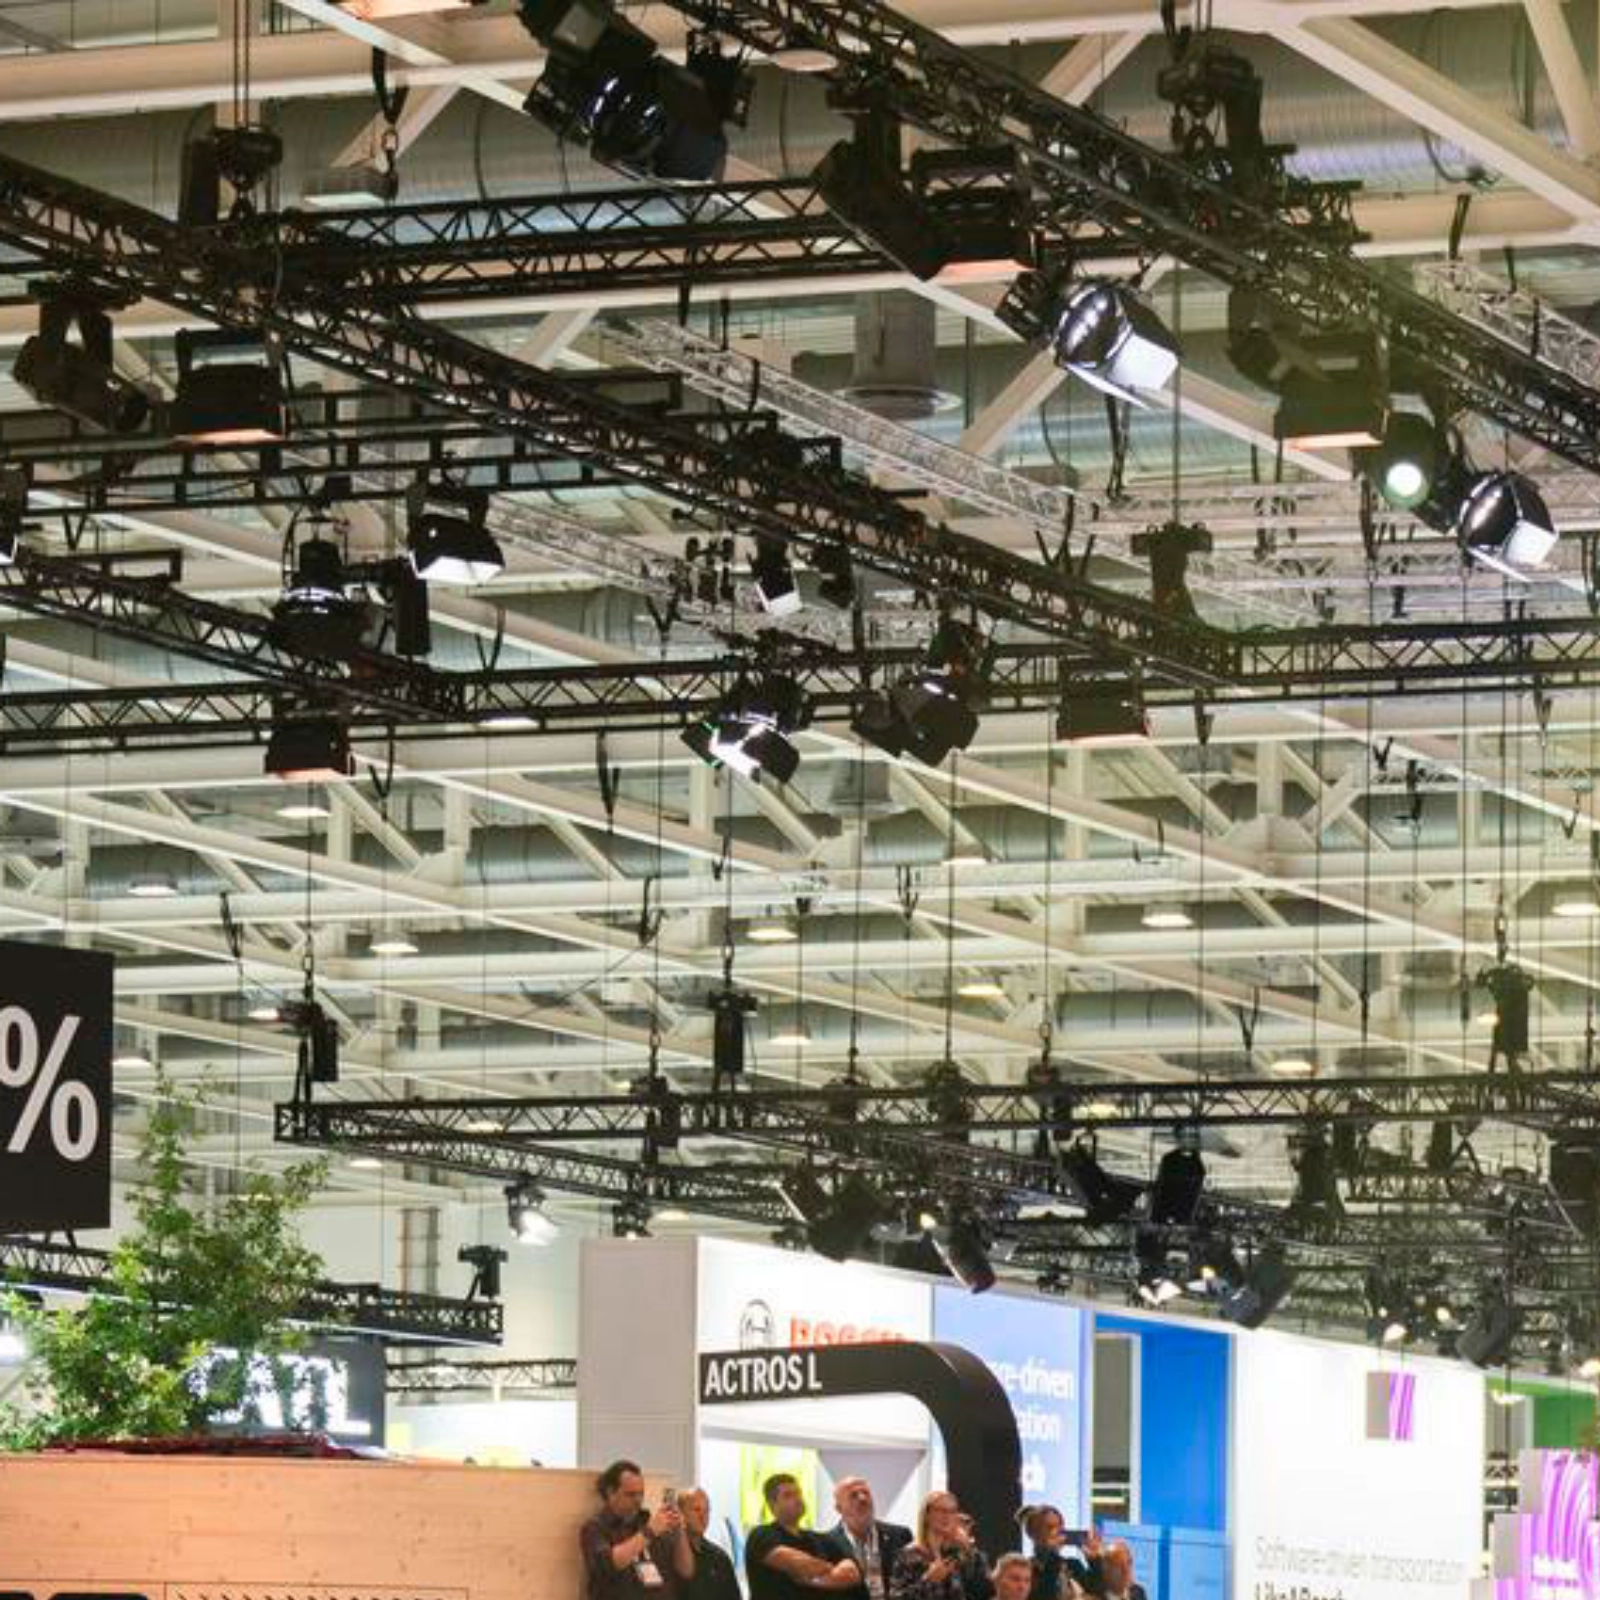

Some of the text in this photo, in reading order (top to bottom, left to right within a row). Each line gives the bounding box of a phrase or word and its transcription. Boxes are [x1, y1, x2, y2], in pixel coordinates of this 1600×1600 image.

[0, 1005, 99, 1162] %
[705, 1353, 822, 1396] ACTROS L
